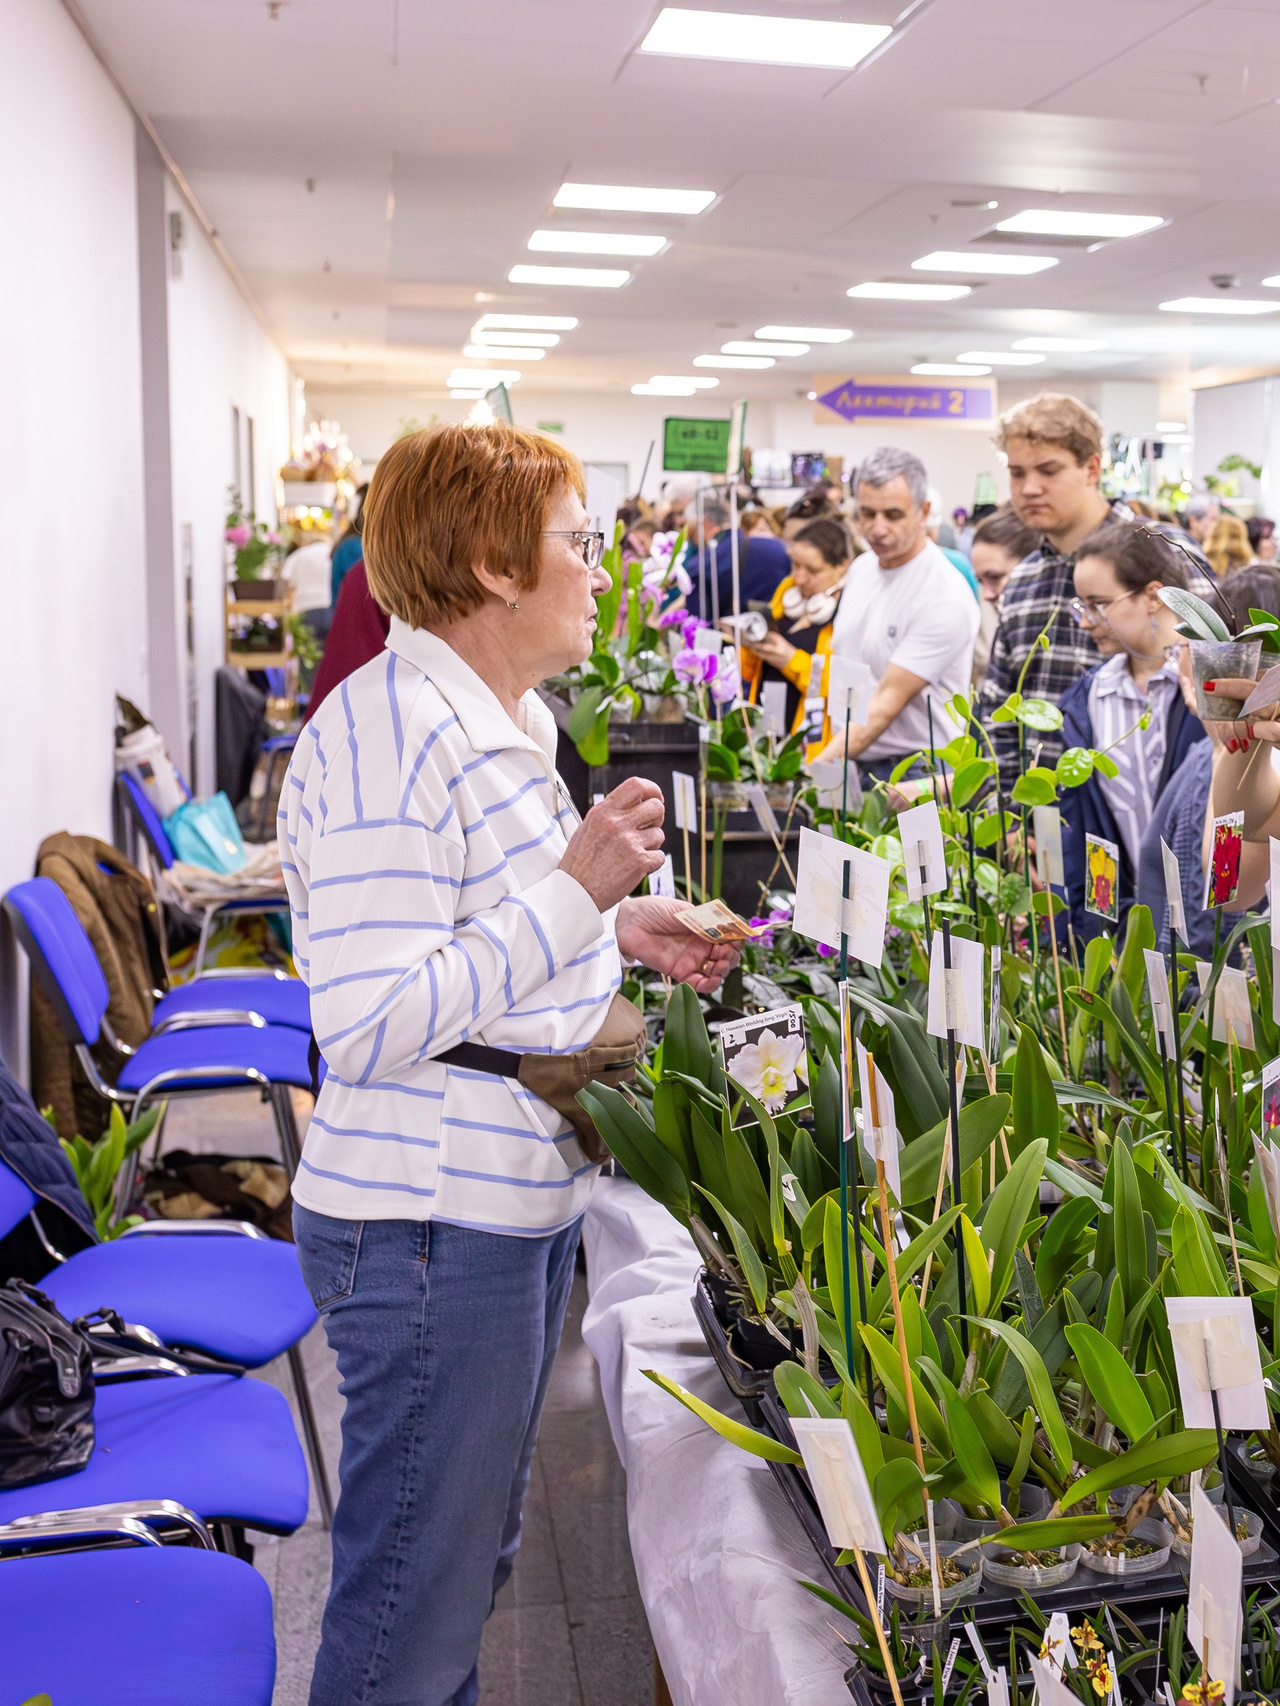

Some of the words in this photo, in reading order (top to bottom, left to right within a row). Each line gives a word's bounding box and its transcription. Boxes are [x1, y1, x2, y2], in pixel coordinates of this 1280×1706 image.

[836, 391, 941, 416] Лекторий
[948, 390, 963, 414] 2
[788, 1009, 797, 1029] 1500
[729, 1034, 736, 1044] 2
